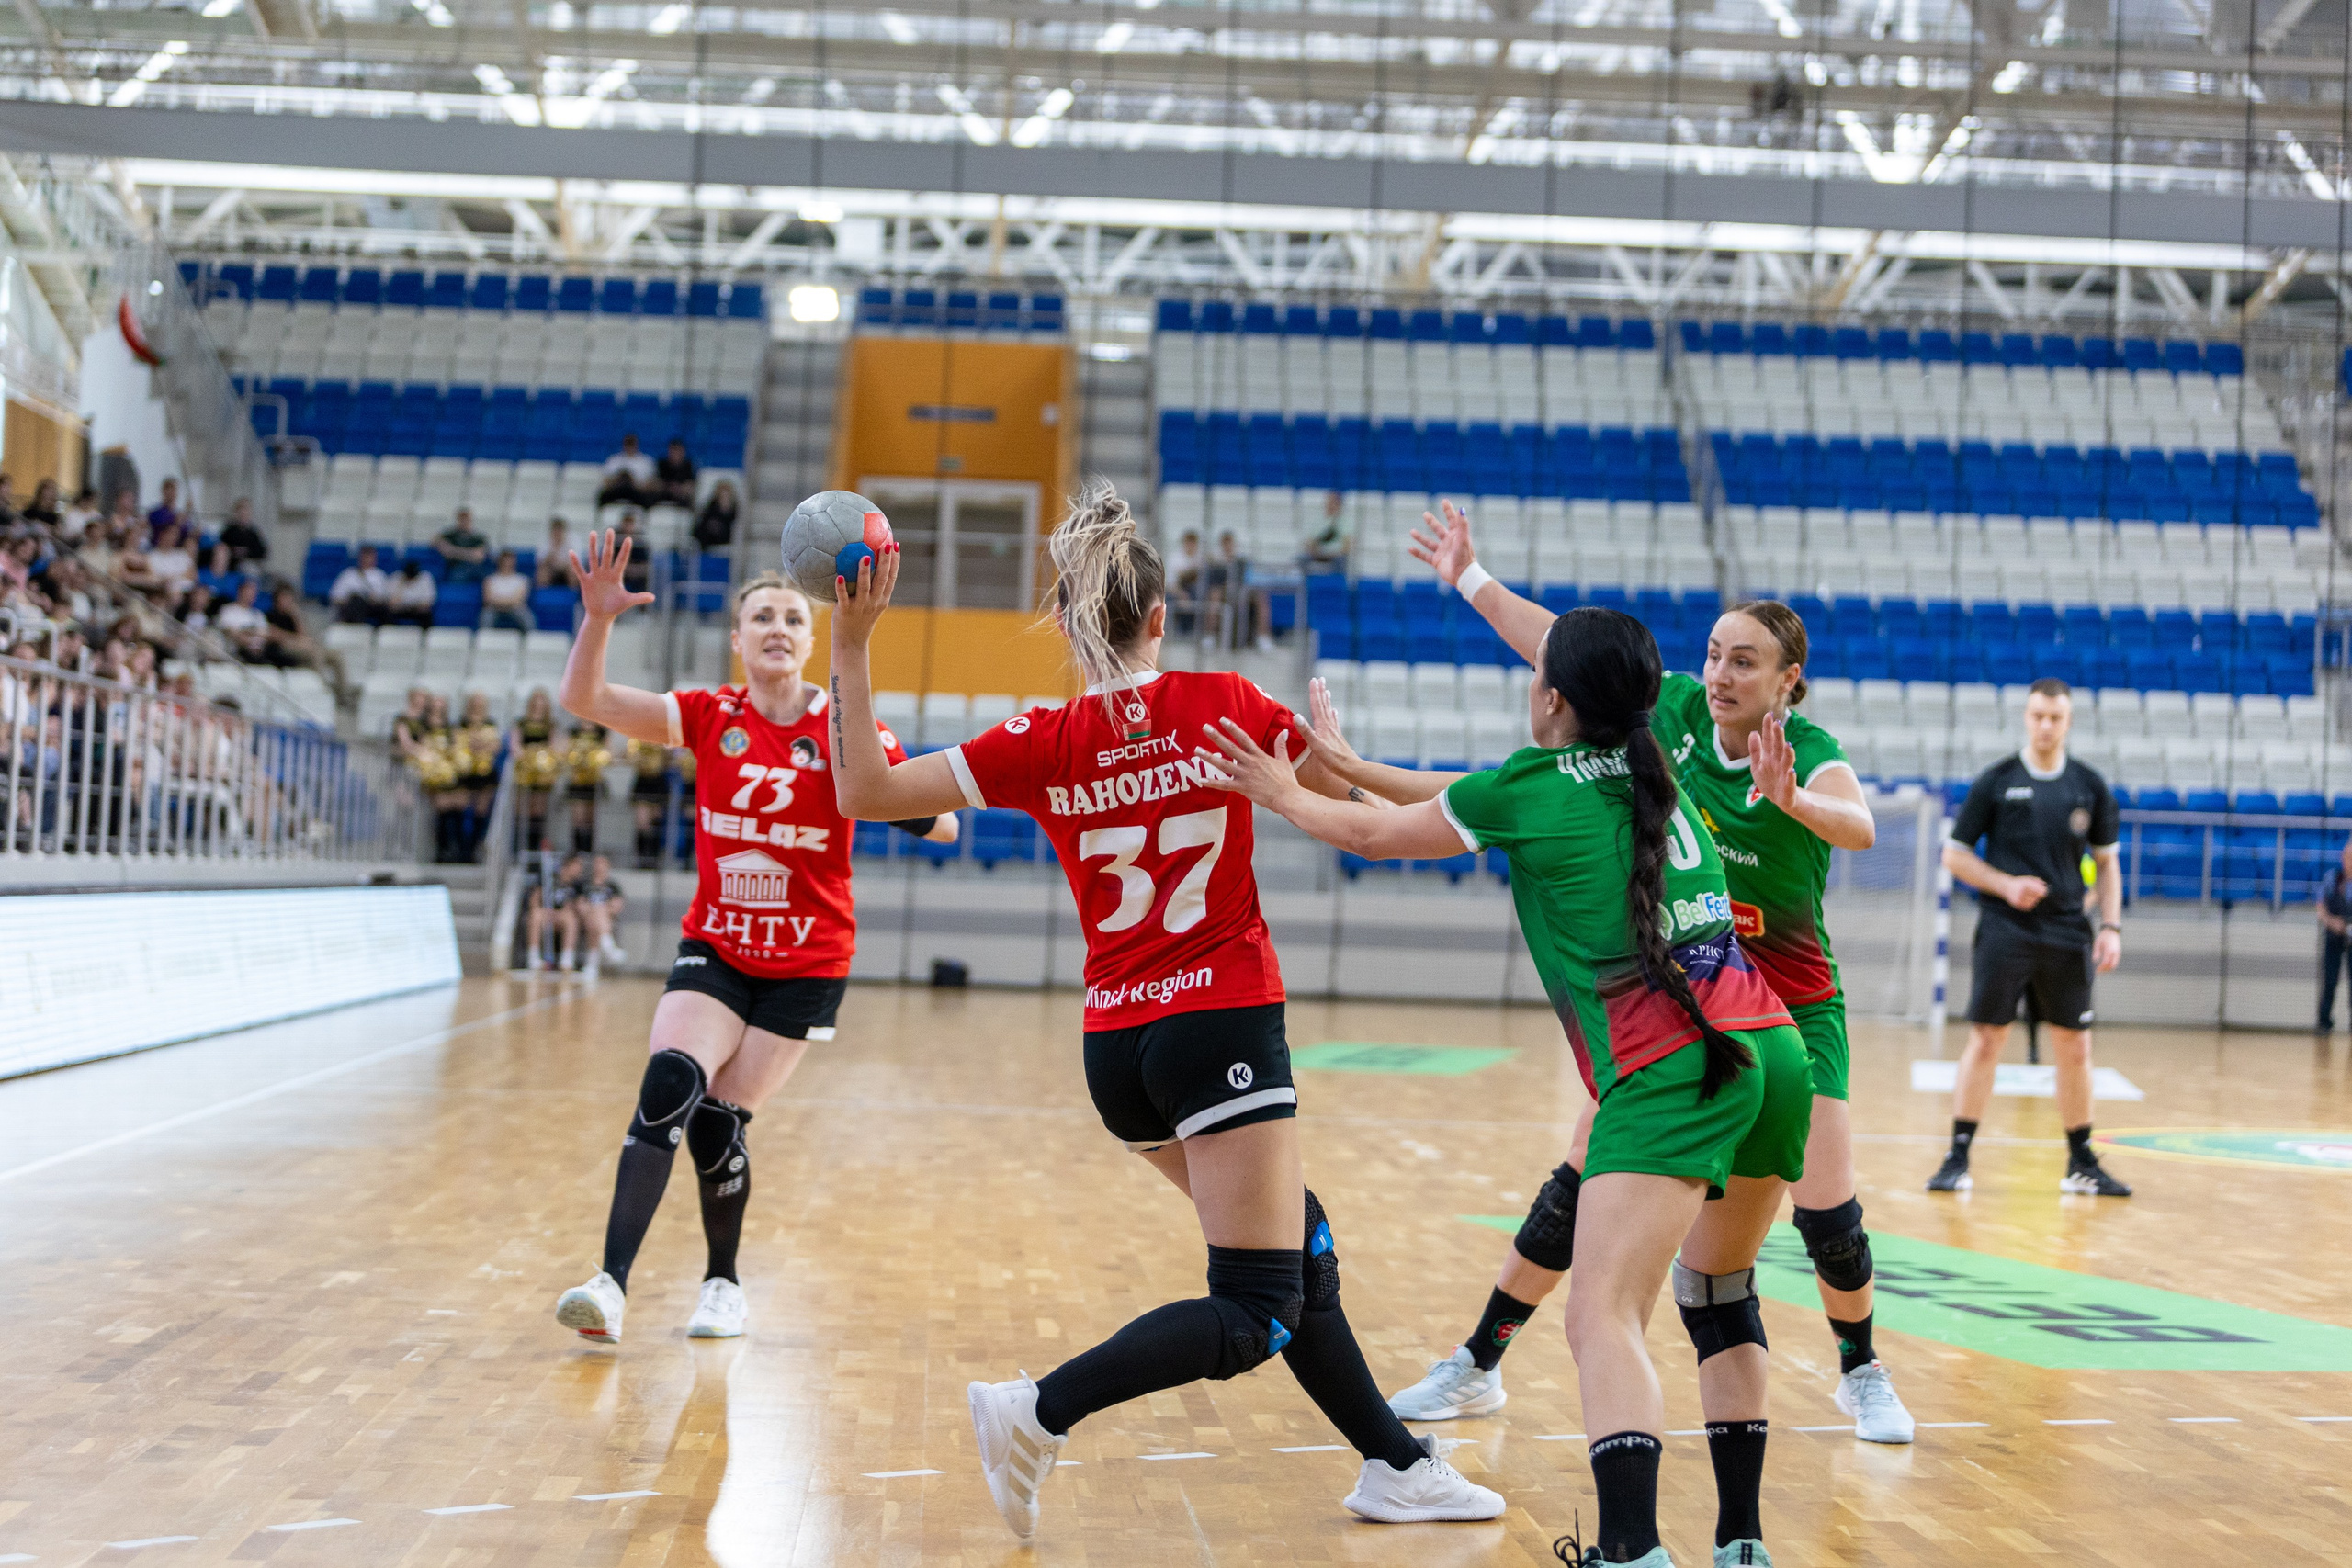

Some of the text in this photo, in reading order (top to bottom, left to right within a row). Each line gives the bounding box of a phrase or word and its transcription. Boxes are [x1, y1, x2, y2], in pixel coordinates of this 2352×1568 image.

[1096, 729, 1184, 768] SPORTIX
[730, 763, 799, 814] 73
[1079, 806, 1228, 934] 37
[1130, 966, 1213, 1005] Region
